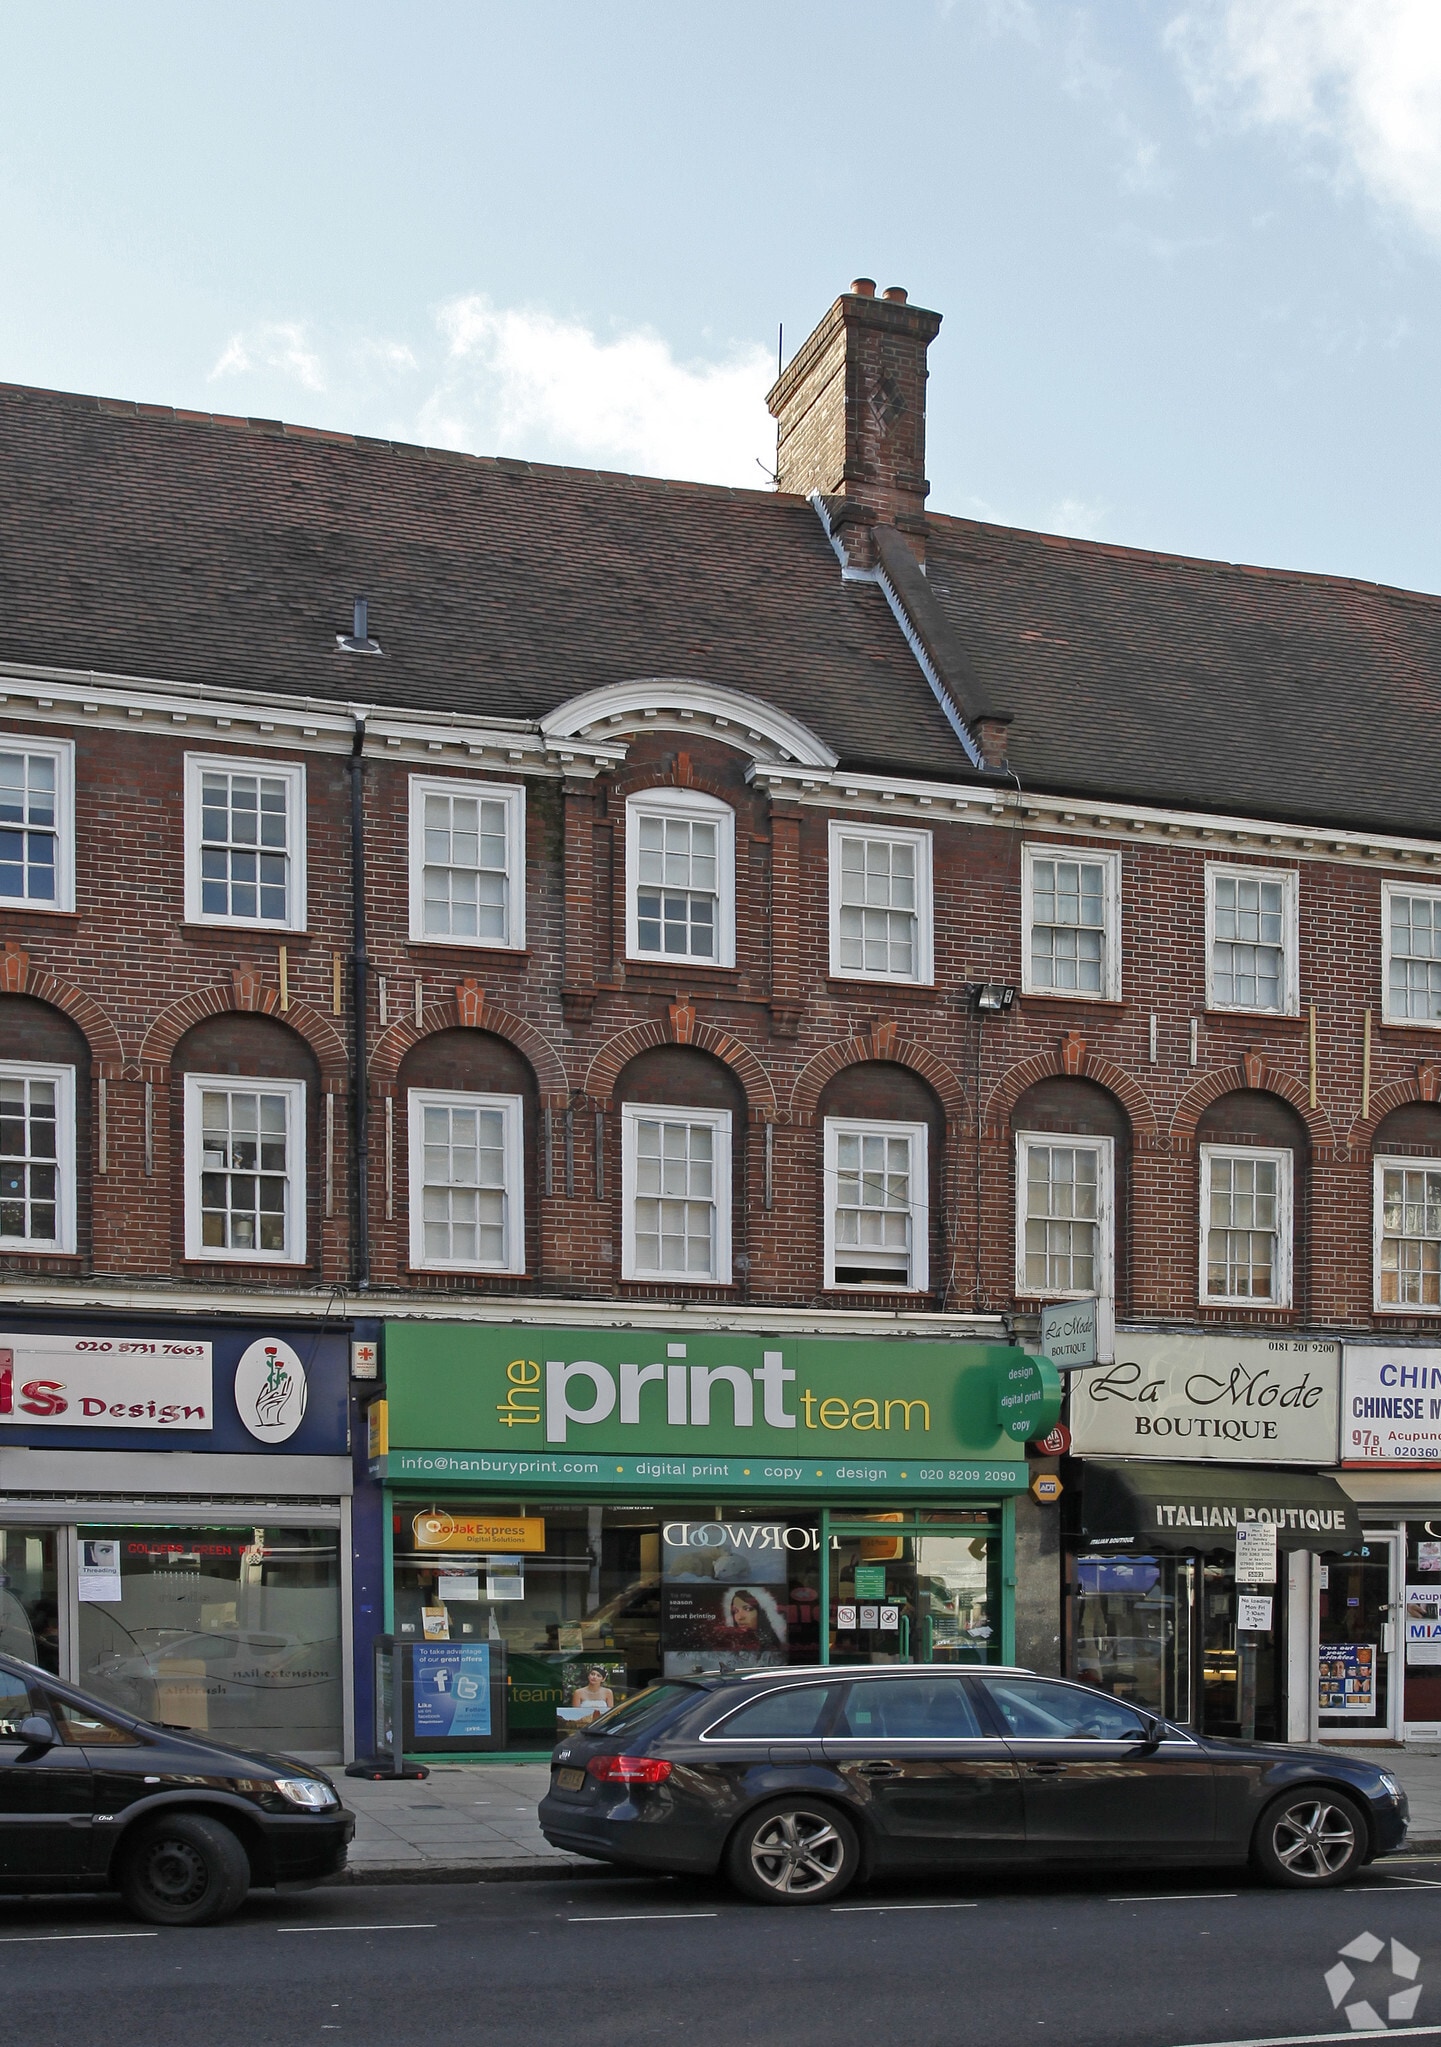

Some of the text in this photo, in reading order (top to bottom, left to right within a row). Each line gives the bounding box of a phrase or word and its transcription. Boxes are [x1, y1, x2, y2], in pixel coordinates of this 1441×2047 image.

[1045, 1316, 1094, 1340] La Mode
[75, 1341, 204, 1356] 020 8731 7663
[1051, 1342, 1086, 1356] BOUTIQUE
[1268, 1342, 1289, 1352] 0181
[1292, 1343, 1308, 1352] 201
[1008, 1366, 1034, 1380] design
[1089, 1362, 1324, 1408] La Mode
[496, 1342, 930, 1444] the print team
[1001, 1390, 1042, 1408] digital print
[78, 1398, 206, 1424] Design
[1352, 1397, 1424, 1420] CHINESE
[1012, 1420, 1030, 1432] copy
[1134, 1416, 1278, 1442] BOUTIQUE
[401, 1456, 1016, 1482] info@hanburyprint.com digital print copy design 020 8209 2090
[1040, 1484, 1056, 1492] ADT
[1156, 1504, 1346, 1531] ITALIAN BOUTIQUE
[476, 1524, 526, 1536] Express
[192, 1544, 231, 1556] GREEN
[1411, 1592, 1441, 1602] Acup
[233, 1668, 330, 1678] nail extension
[164, 1684, 226, 1695] airbrush
[512, 1687, 562, 1702] team
